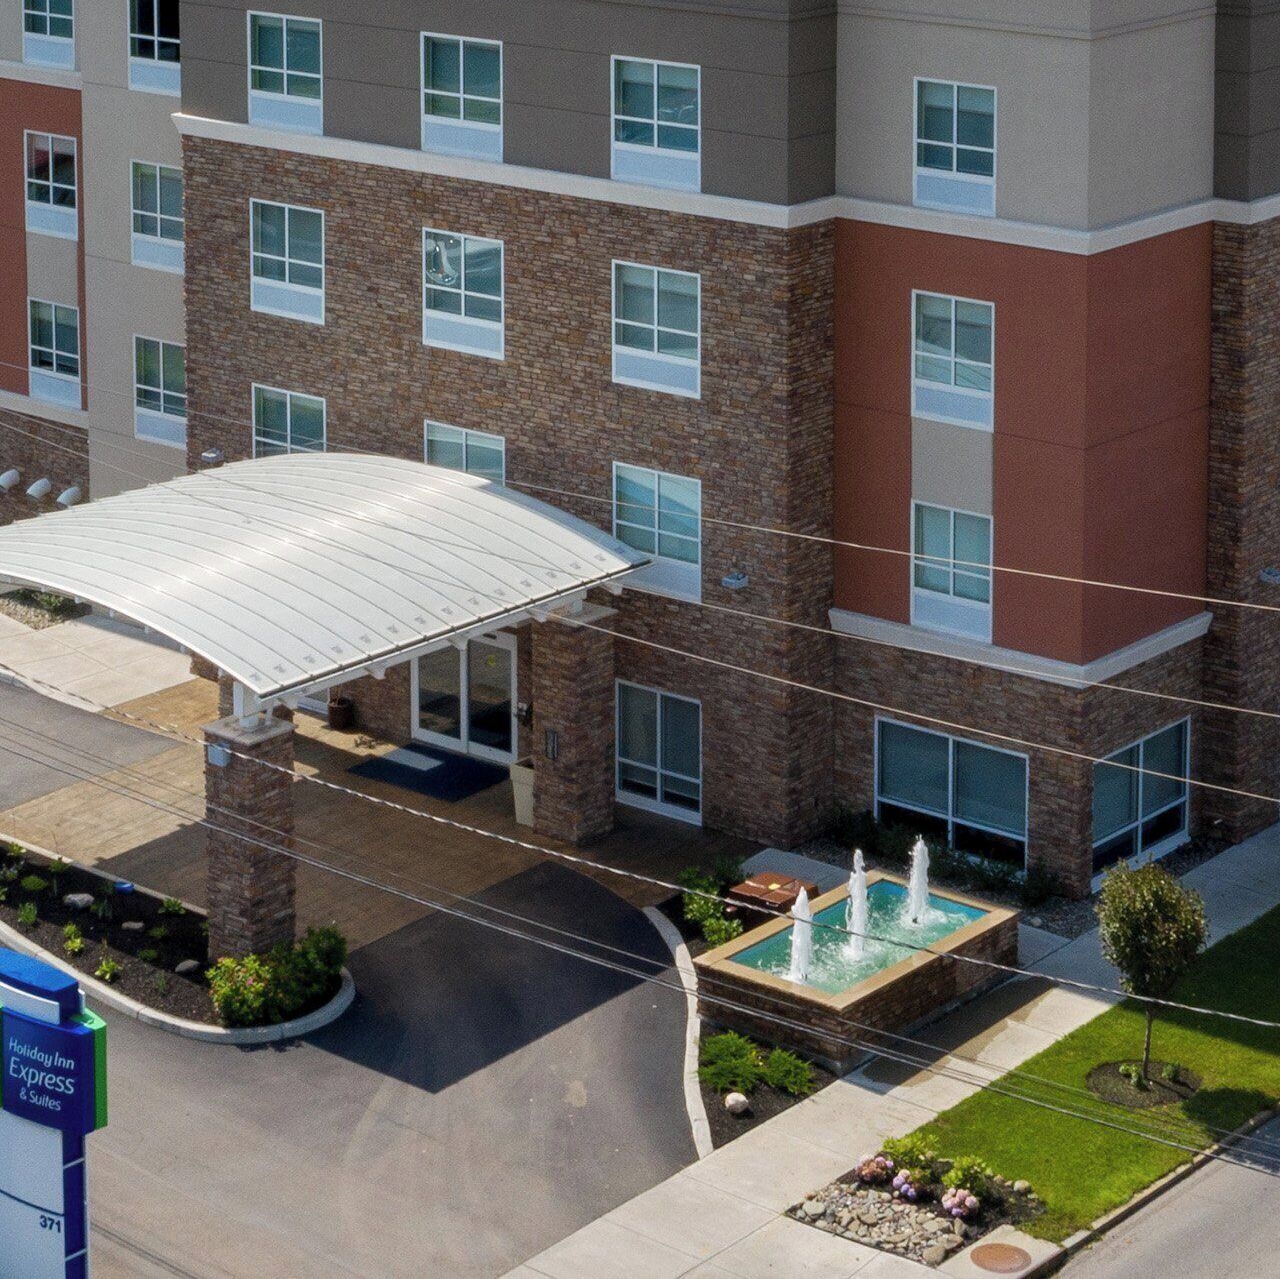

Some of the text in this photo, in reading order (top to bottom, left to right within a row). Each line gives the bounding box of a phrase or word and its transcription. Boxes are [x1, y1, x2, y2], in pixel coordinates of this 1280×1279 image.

[9, 1037, 75, 1070] Holiday Inn
[9, 1056, 75, 1094] Express
[19, 1087, 61, 1111] & Suites
[39, 1214, 61, 1233] 371
